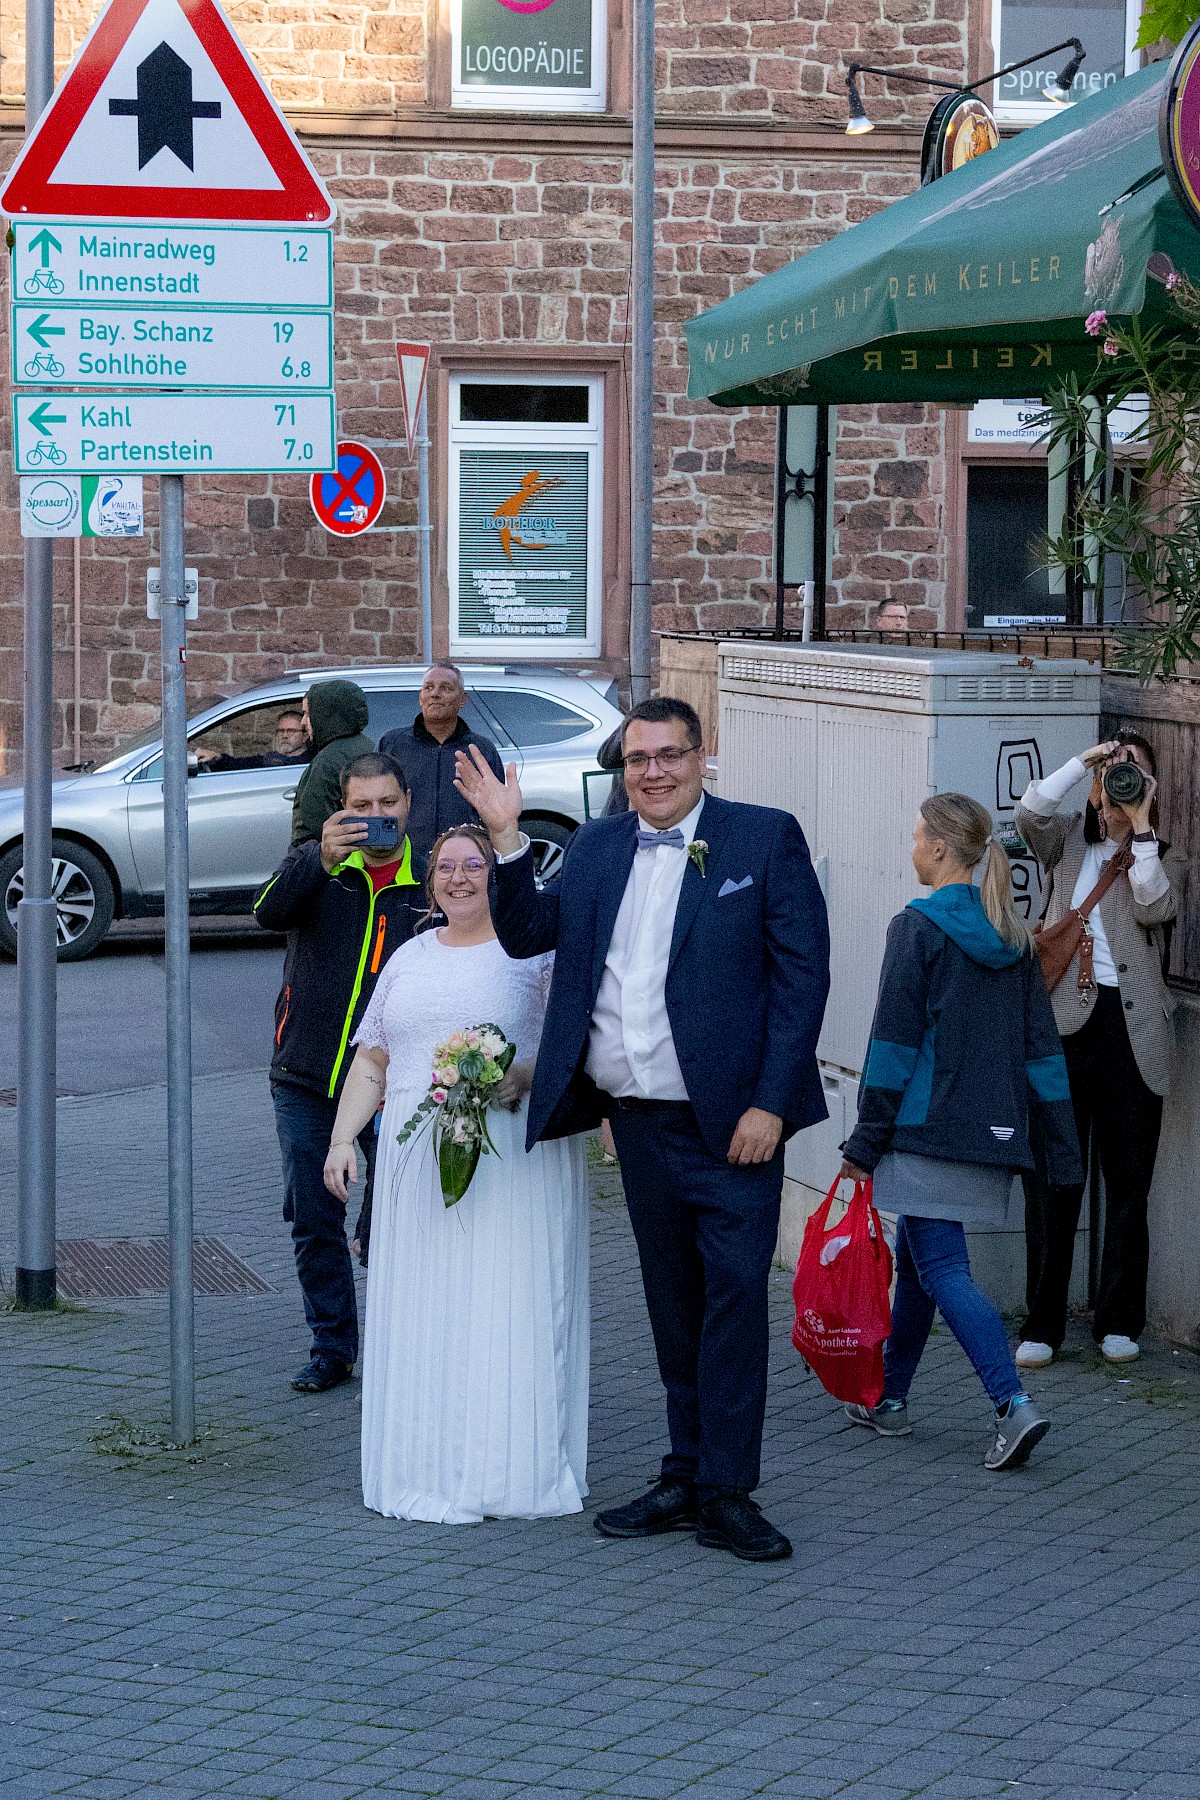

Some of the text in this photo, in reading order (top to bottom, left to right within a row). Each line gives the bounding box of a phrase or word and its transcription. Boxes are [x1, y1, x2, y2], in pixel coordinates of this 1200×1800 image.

[465, 41, 584, 74] LOGOPÄDIE
[79, 235, 308, 265] Mainradweg 1,2
[78, 269, 200, 293] Innenstadt
[705, 255, 1060, 365] NUR ECHT MIT DEM KEILER
[80, 318, 294, 345] Bay. Schanz 19
[78, 352, 311, 379] Sohlhöhe 6,8
[81, 404, 296, 427] Kahl 71
[975, 428, 994, 437] Das
[81, 438, 313, 461] Partenstein 7,0
[483, 517, 556, 530] BOTHOR
